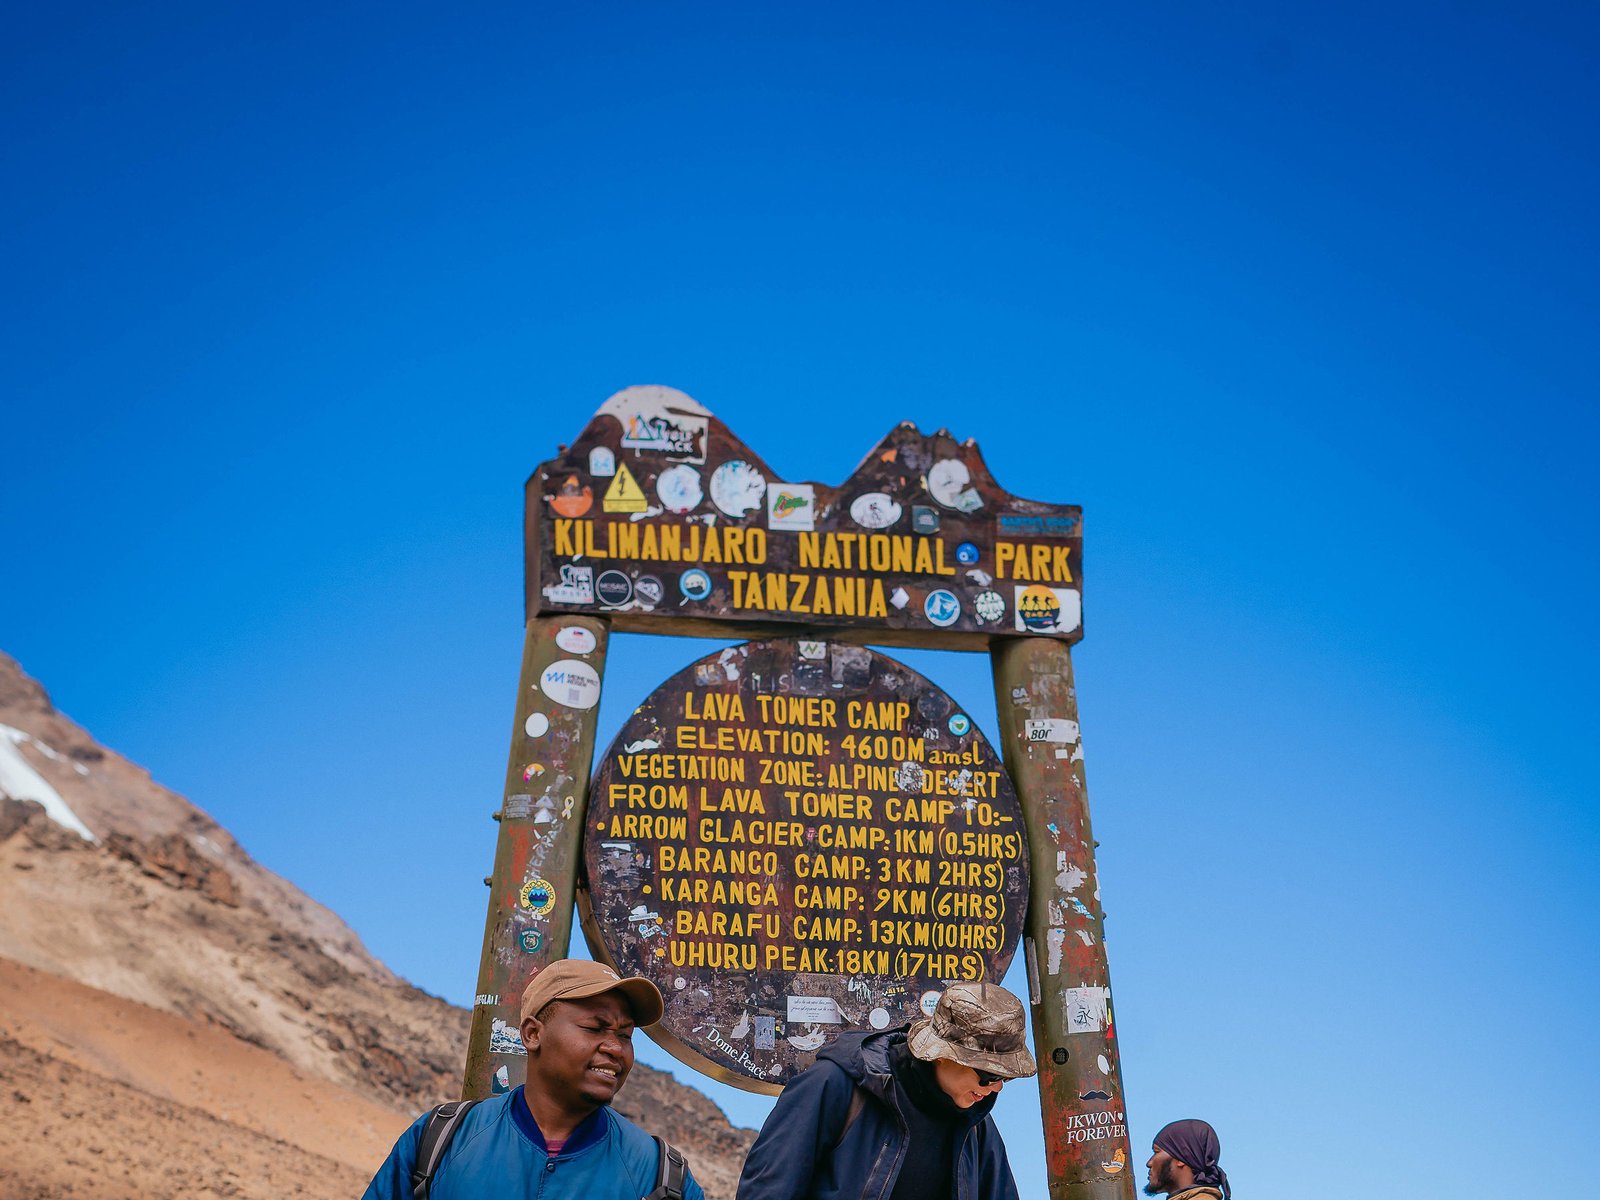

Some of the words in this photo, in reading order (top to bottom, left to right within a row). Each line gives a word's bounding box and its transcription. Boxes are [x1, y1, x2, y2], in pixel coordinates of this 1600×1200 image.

[555, 519, 766, 564] KILIMANJARO
[799, 532, 955, 576] NATIONAL
[996, 542, 1073, 583] PARK
[728, 571, 888, 618] TANZANIA
[686, 692, 745, 722] LAVA
[756, 696, 836, 729] TOWER
[848, 700, 909, 731] CAMP
[676, 726, 830, 758] ELEVATION:
[841, 734, 925, 763] 4600M
[928, 740, 984, 766] amsl
[618, 755, 744, 784] VEGETATION
[609, 784, 688, 811] FROM
[700, 787, 765, 815] LAVA
[784, 791, 872, 821] TOWER
[886, 797, 954, 825] CAMP
[610, 815, 686, 843] ARROW
[700, 818, 804, 847] GLACIER
[660, 846, 778, 877] BARANCO
[795, 854, 871, 881] CAMP:
[939, 861, 1004, 892] 2HRS)
[661, 878, 779, 909] KARANGA
[795, 885, 865, 911] CAMP:
[676, 910, 780, 939] BARAFU
[794, 916, 862, 942] CAMP:
[670, 941, 757, 971] UHURU
[706, 1028, 767, 1080] Dome.Peace
[1066, 1110, 1118, 1130] JKWON
[1067, 1125, 1127, 1144] FOREVER
